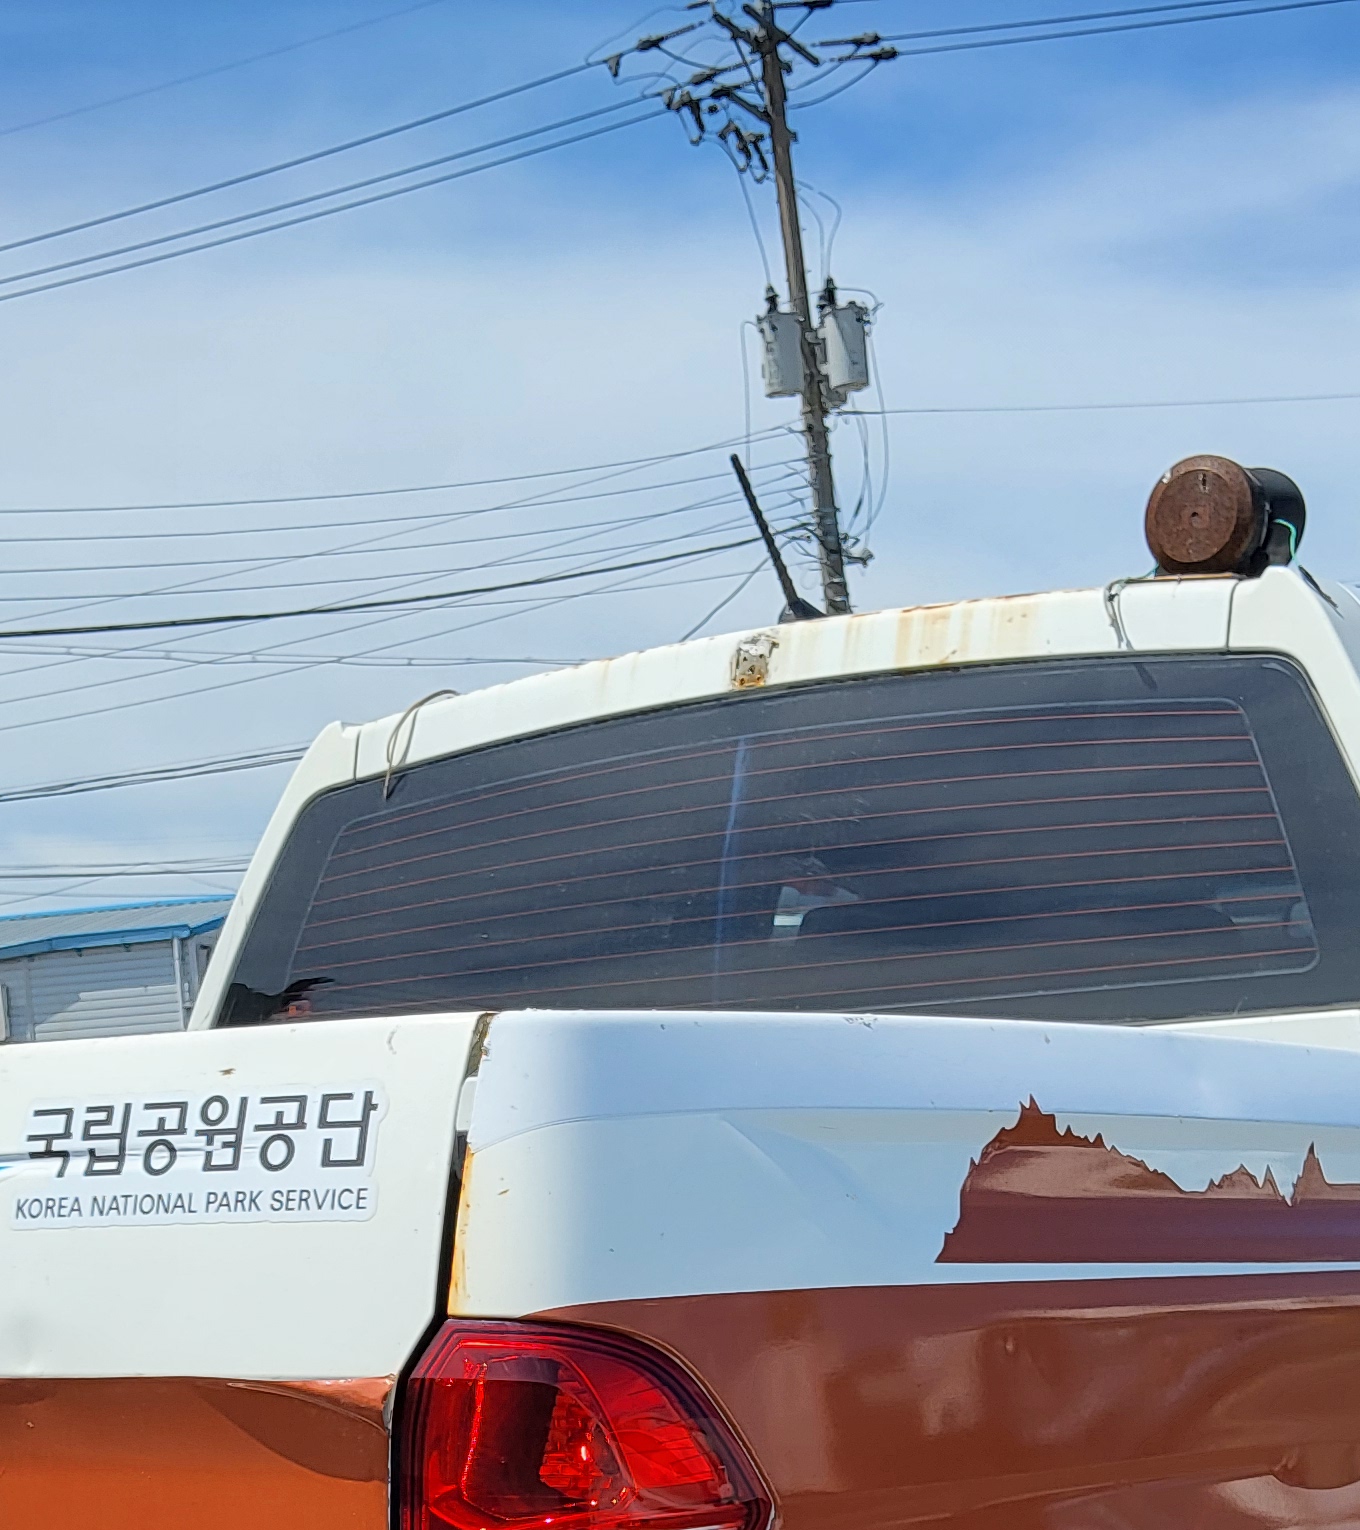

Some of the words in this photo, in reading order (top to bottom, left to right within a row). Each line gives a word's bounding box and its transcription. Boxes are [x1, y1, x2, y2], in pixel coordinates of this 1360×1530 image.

[26, 1090, 378, 1178] 국립공원공단
[15, 1198, 83, 1220] KOREA
[90, 1193, 197, 1219] NATIONAL
[204, 1190, 263, 1214] PARK
[269, 1187, 369, 1213] SERVICE
